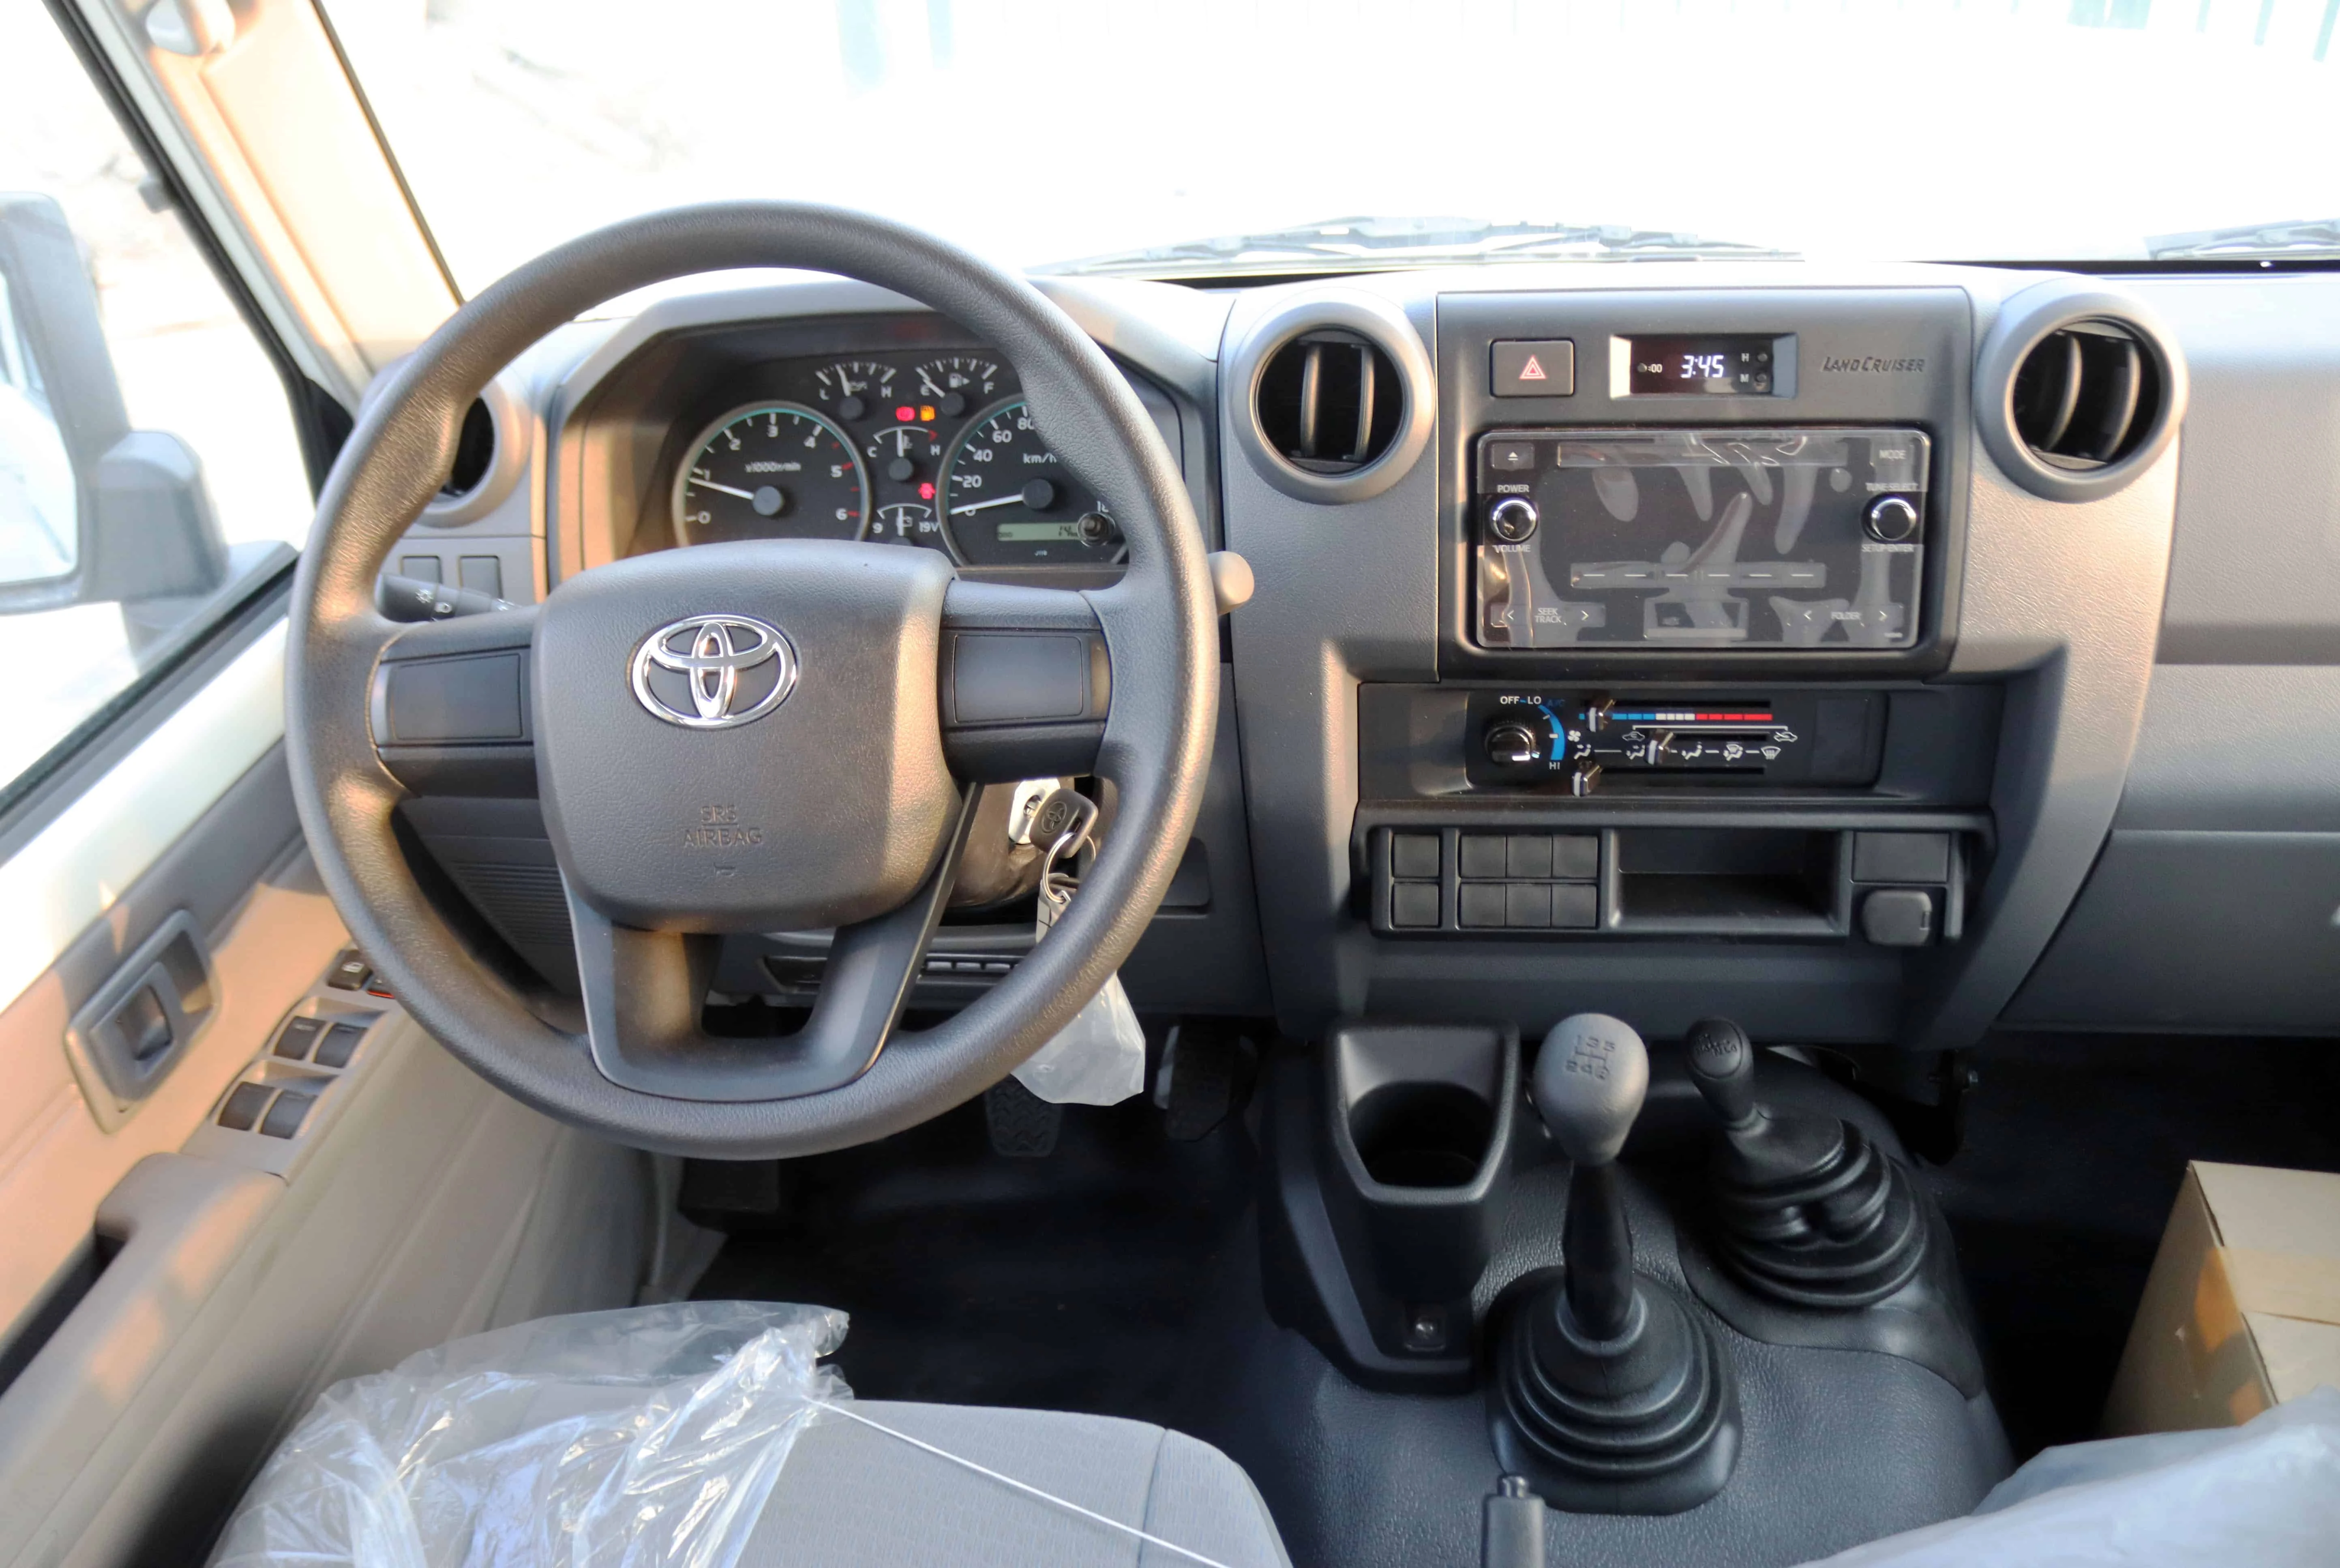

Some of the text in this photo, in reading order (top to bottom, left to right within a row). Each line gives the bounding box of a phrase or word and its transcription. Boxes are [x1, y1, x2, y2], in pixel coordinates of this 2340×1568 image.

[1741, 353, 1749, 362] H
[1680, 355, 1724, 378] 3:45
[1740, 374, 1749, 382] M
[881, 387, 892, 398] H
[920, 385, 930, 396] E
[984, 382, 994, 394] F
[819, 389, 829, 400] L
[767, 425, 778, 437] 3
[992, 430, 1012, 443] 60
[729, 439, 741, 450] 2
[804, 436, 816, 448] 4
[868, 447, 877, 458] C
[930, 444, 941, 456] H
[974, 450, 993, 462] 40
[831, 465, 843, 478] 5
[962, 475, 982, 488] 20
[1497, 484, 1530, 493] POWER
[697, 511, 711, 524] 0
[835, 508, 848, 521] 6
[872, 523, 883, 534] 9
[1494, 544, 1531, 553] VOLUME
[1534, 615, 1562, 623] TRACK
[1500, 696, 1542, 705] OFF LO
[1549, 761, 1560, 770] HI
[700, 805, 737, 823] SRS
[684, 827, 763, 848] AIRBAG
